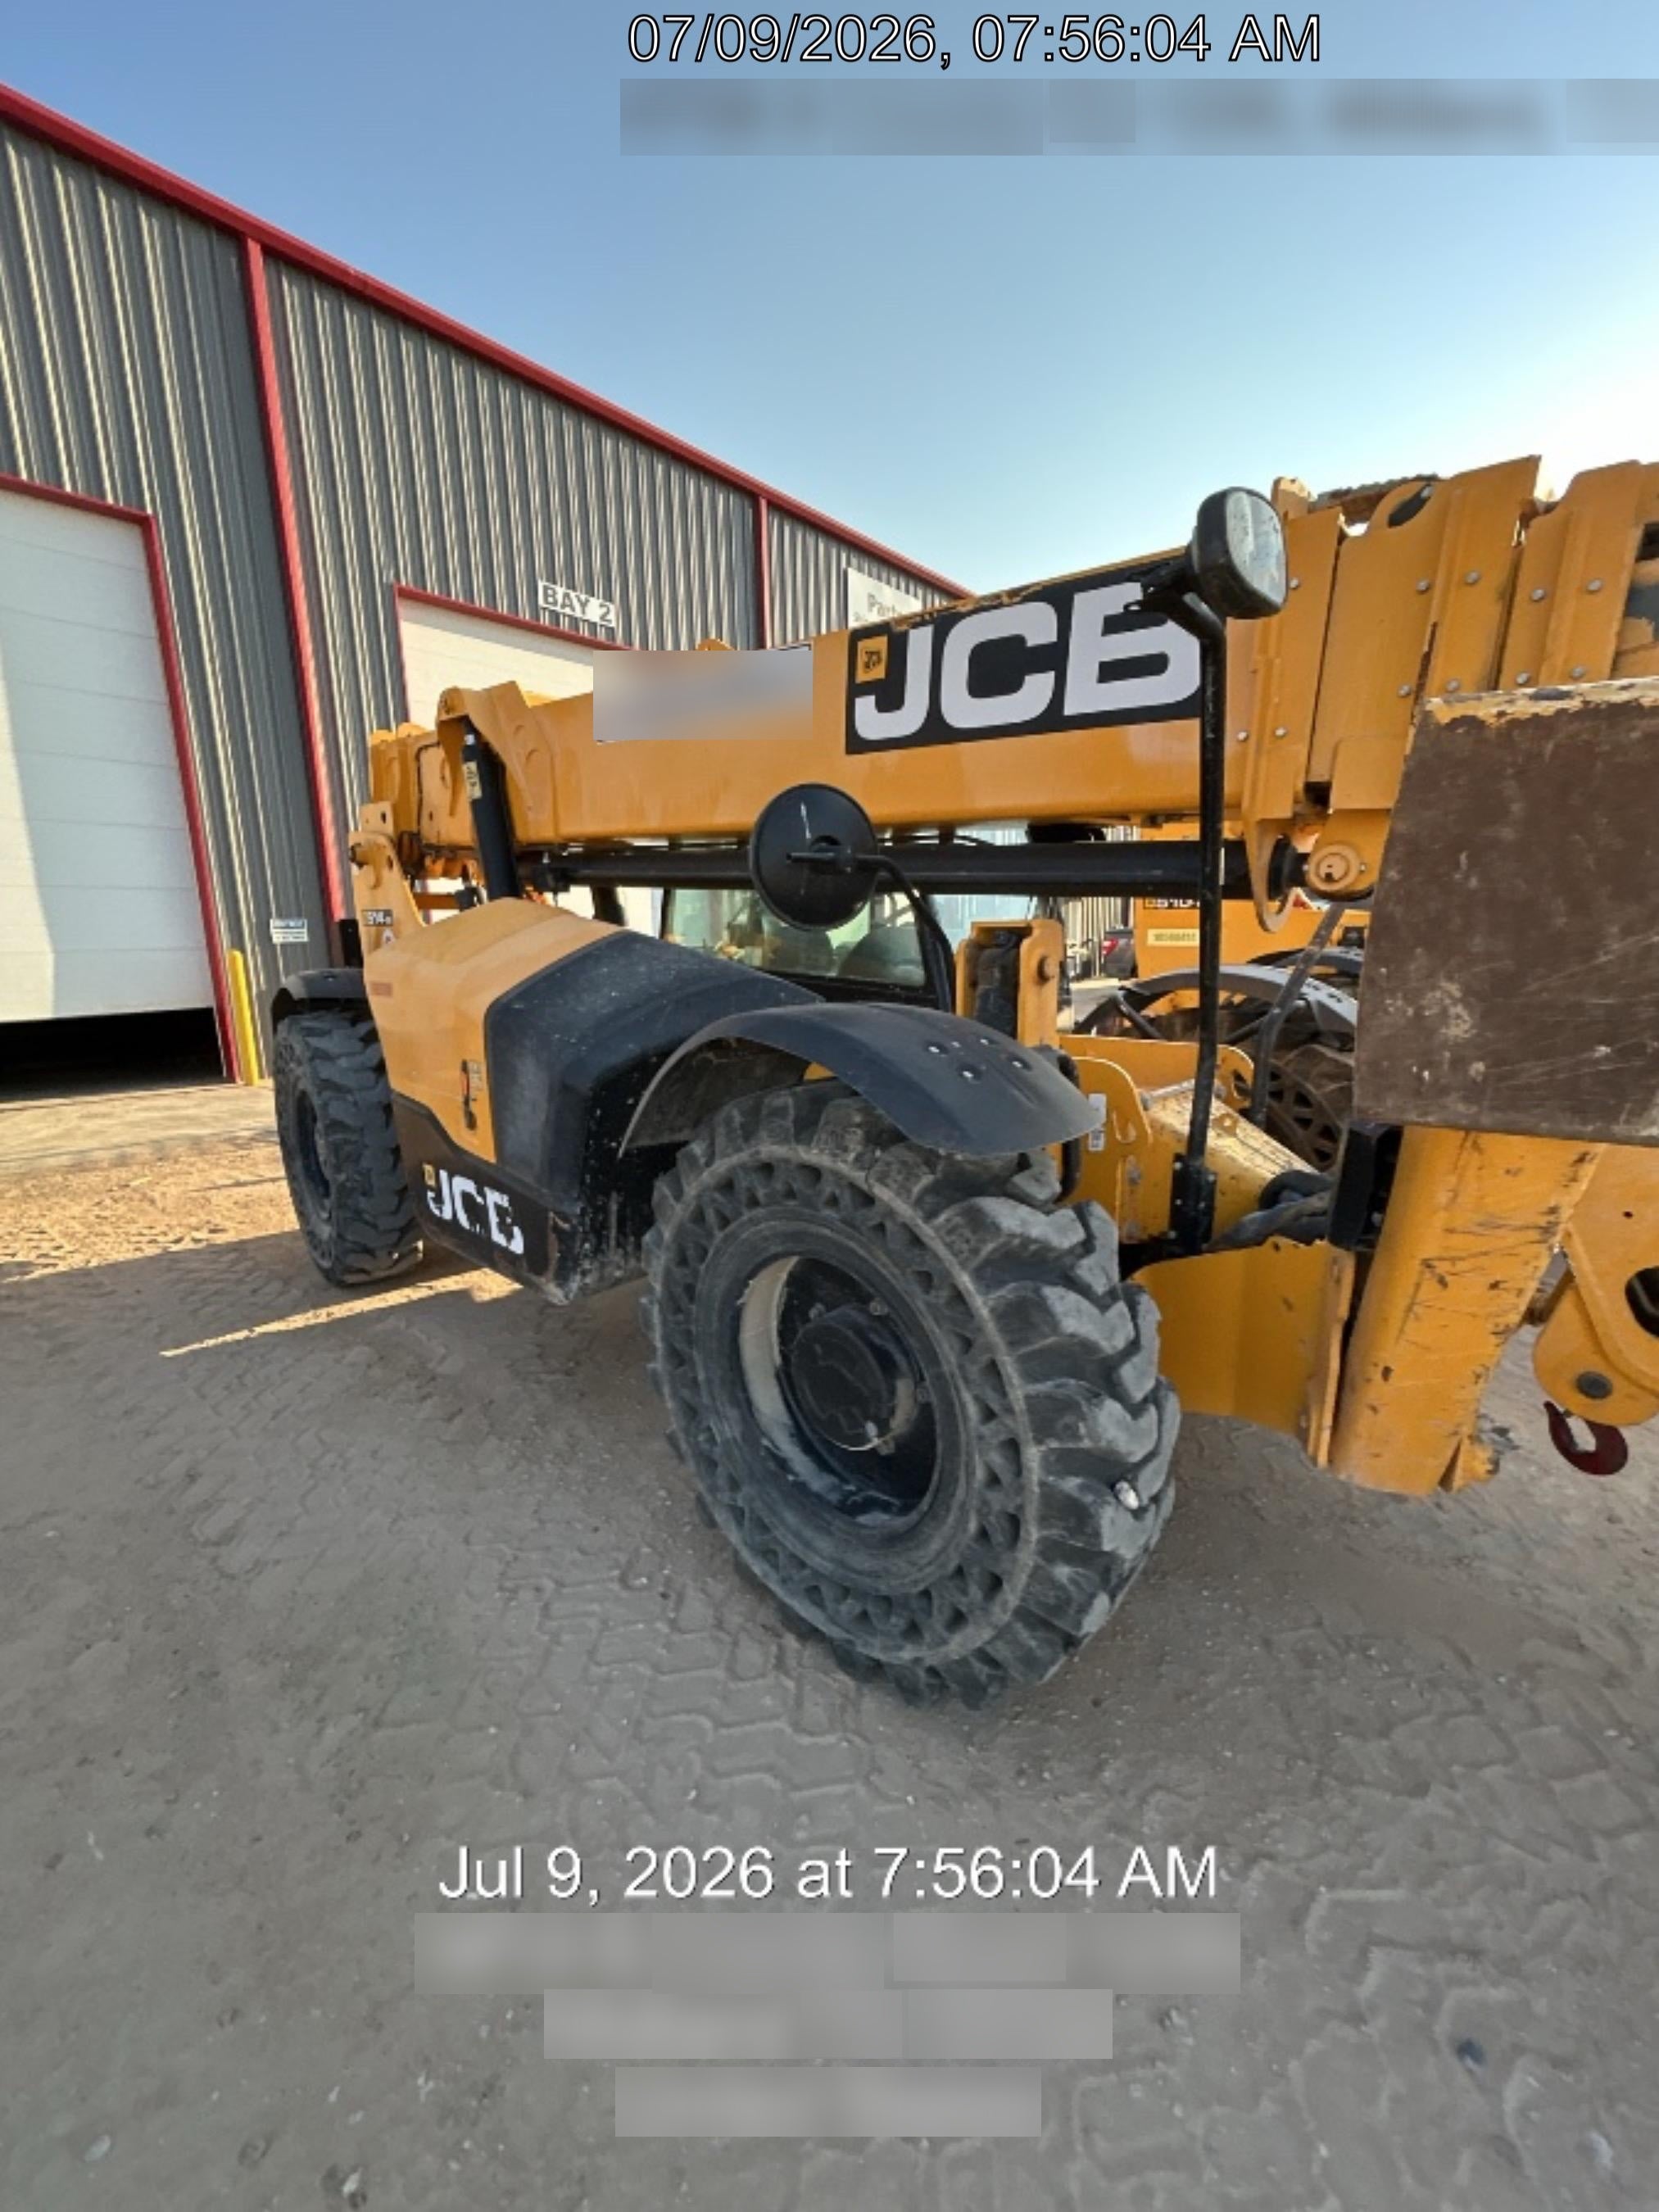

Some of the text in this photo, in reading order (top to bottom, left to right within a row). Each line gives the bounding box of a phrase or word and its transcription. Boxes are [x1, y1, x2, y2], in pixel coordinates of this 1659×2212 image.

[542, 585, 613, 623] BAY 2
[867, 592, 900, 617] Part
[854, 582, 1201, 740] JCB
